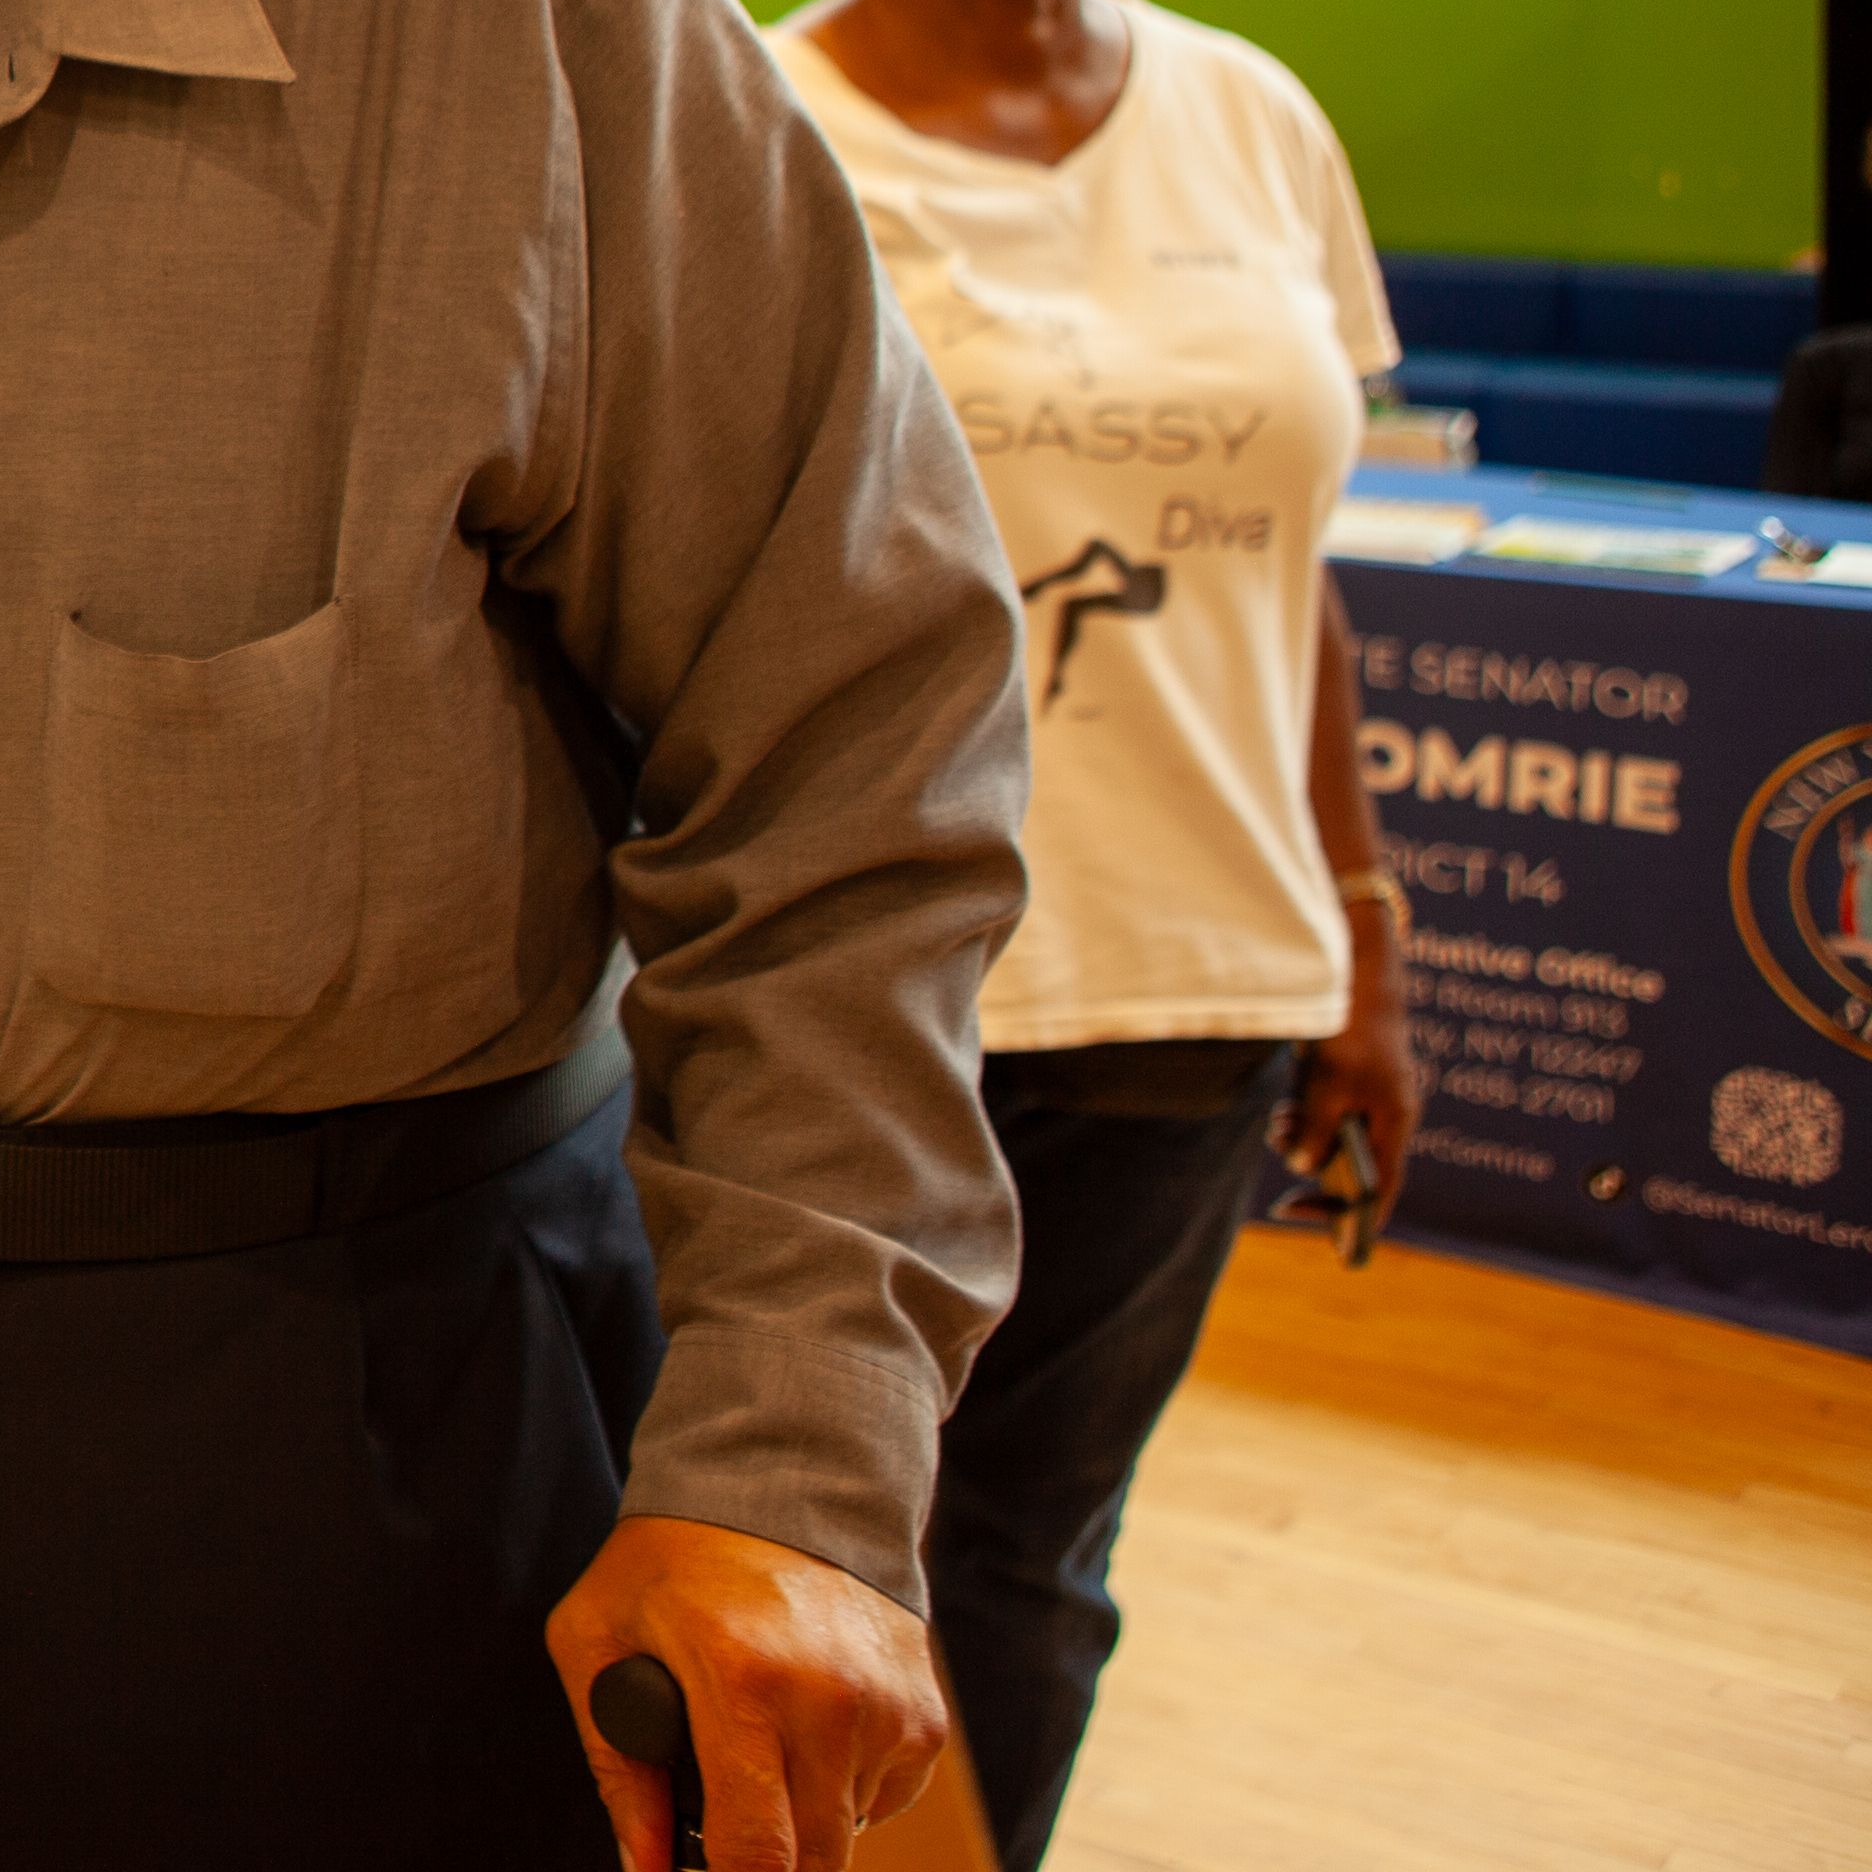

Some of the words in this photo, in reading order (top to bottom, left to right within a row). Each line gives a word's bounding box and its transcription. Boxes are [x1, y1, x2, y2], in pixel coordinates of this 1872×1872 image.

[960, 392, 1269, 466] SASSY
[1156, 495, 1274, 553] Diva
[1409, 639, 1690, 726] SENATOR
[1763, 747, 1861, 841] NEW
[1502, 849, 1568, 908] 14
[1535, 945, 1667, 1006] Office
